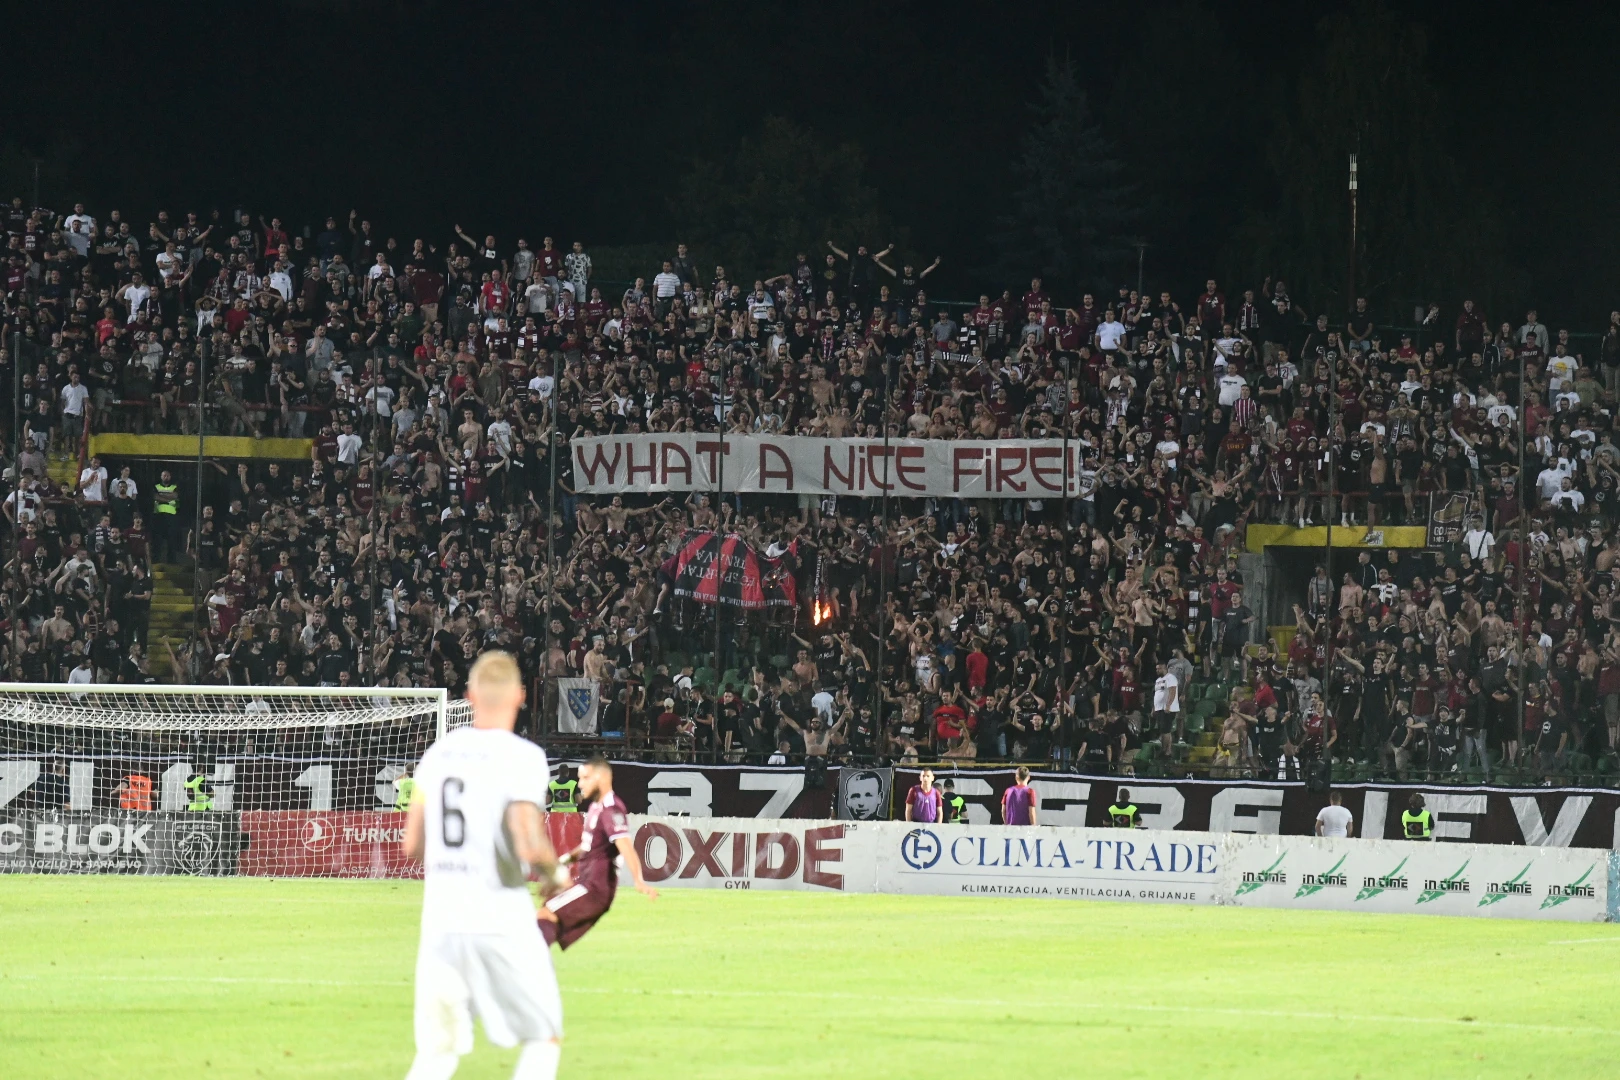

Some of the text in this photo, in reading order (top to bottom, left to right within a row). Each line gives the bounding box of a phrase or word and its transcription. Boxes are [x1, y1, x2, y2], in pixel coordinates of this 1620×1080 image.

[577, 440, 730, 487] WHAT
[759, 444, 793, 490] A
[442, 776, 465, 848] 6
[34, 824, 153, 853] BLOK
[343, 828, 408, 843] TURKIS
[30, 860, 68, 869] VOZILO
[71, 861, 83, 869] FK
[86, 860, 142, 869] SARAJEVO
[633, 822, 845, 891] OXIDE
[951, 836, 1218, 874] CLIMA-TRADE
[350, 866, 377, 874] STAR
[380, 866, 426, 875] ALLIANC
[725, 880, 750, 889] GYM
[962, 884, 1196, 901] KLIMATIZACIJA, VENTILACIJA, GRIJANJE
